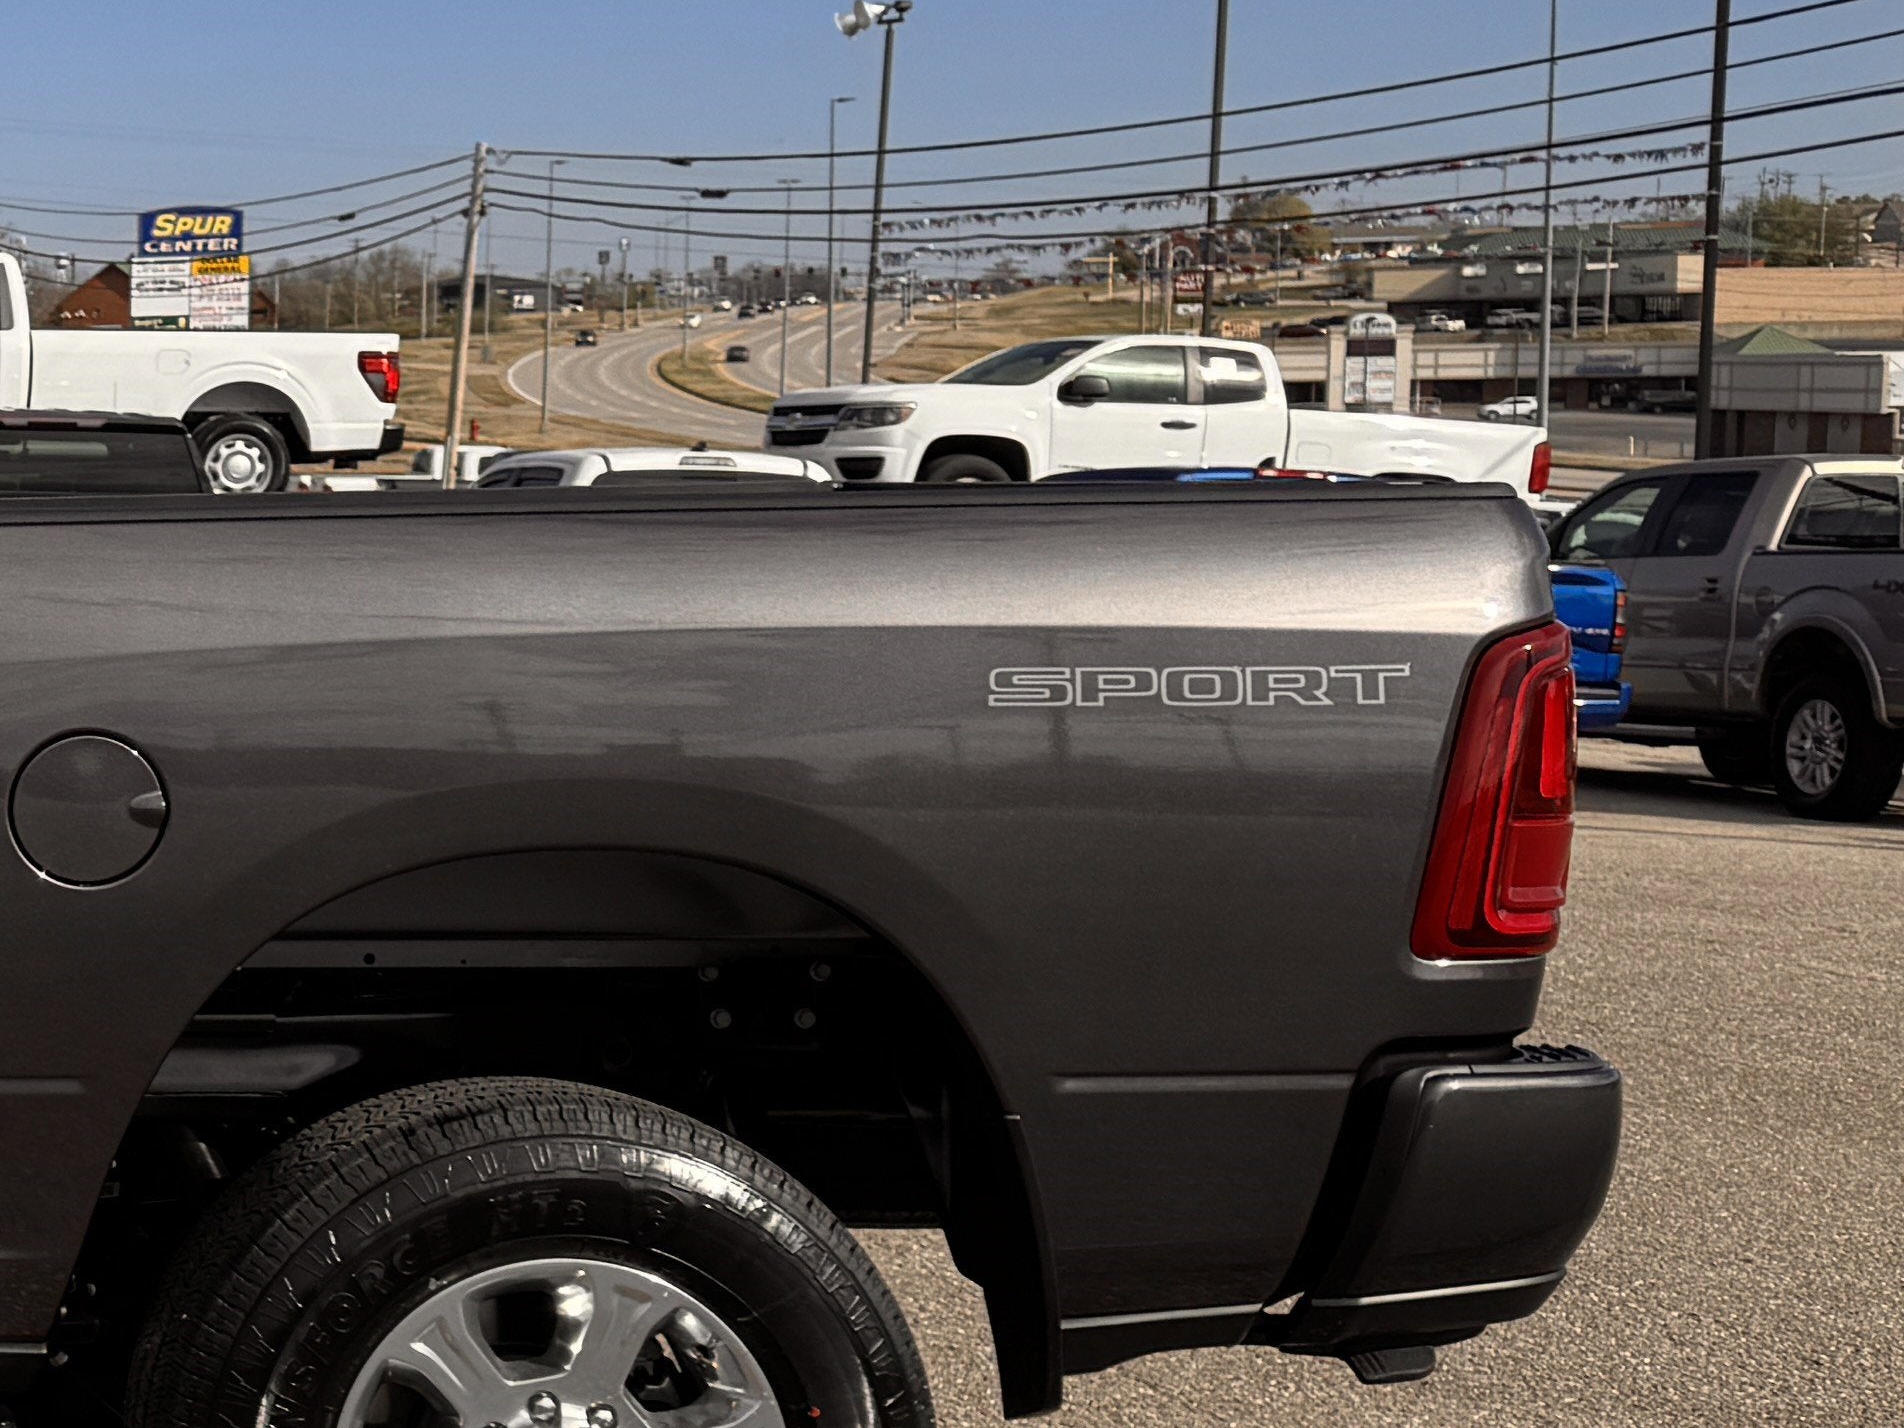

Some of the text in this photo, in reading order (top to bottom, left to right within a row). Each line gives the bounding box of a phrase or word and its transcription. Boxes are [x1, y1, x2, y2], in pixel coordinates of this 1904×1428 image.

[153, 213, 233, 238] SPUR
[143, 237, 239, 253] CENTER
[988, 662, 1411, 707] SPORT
